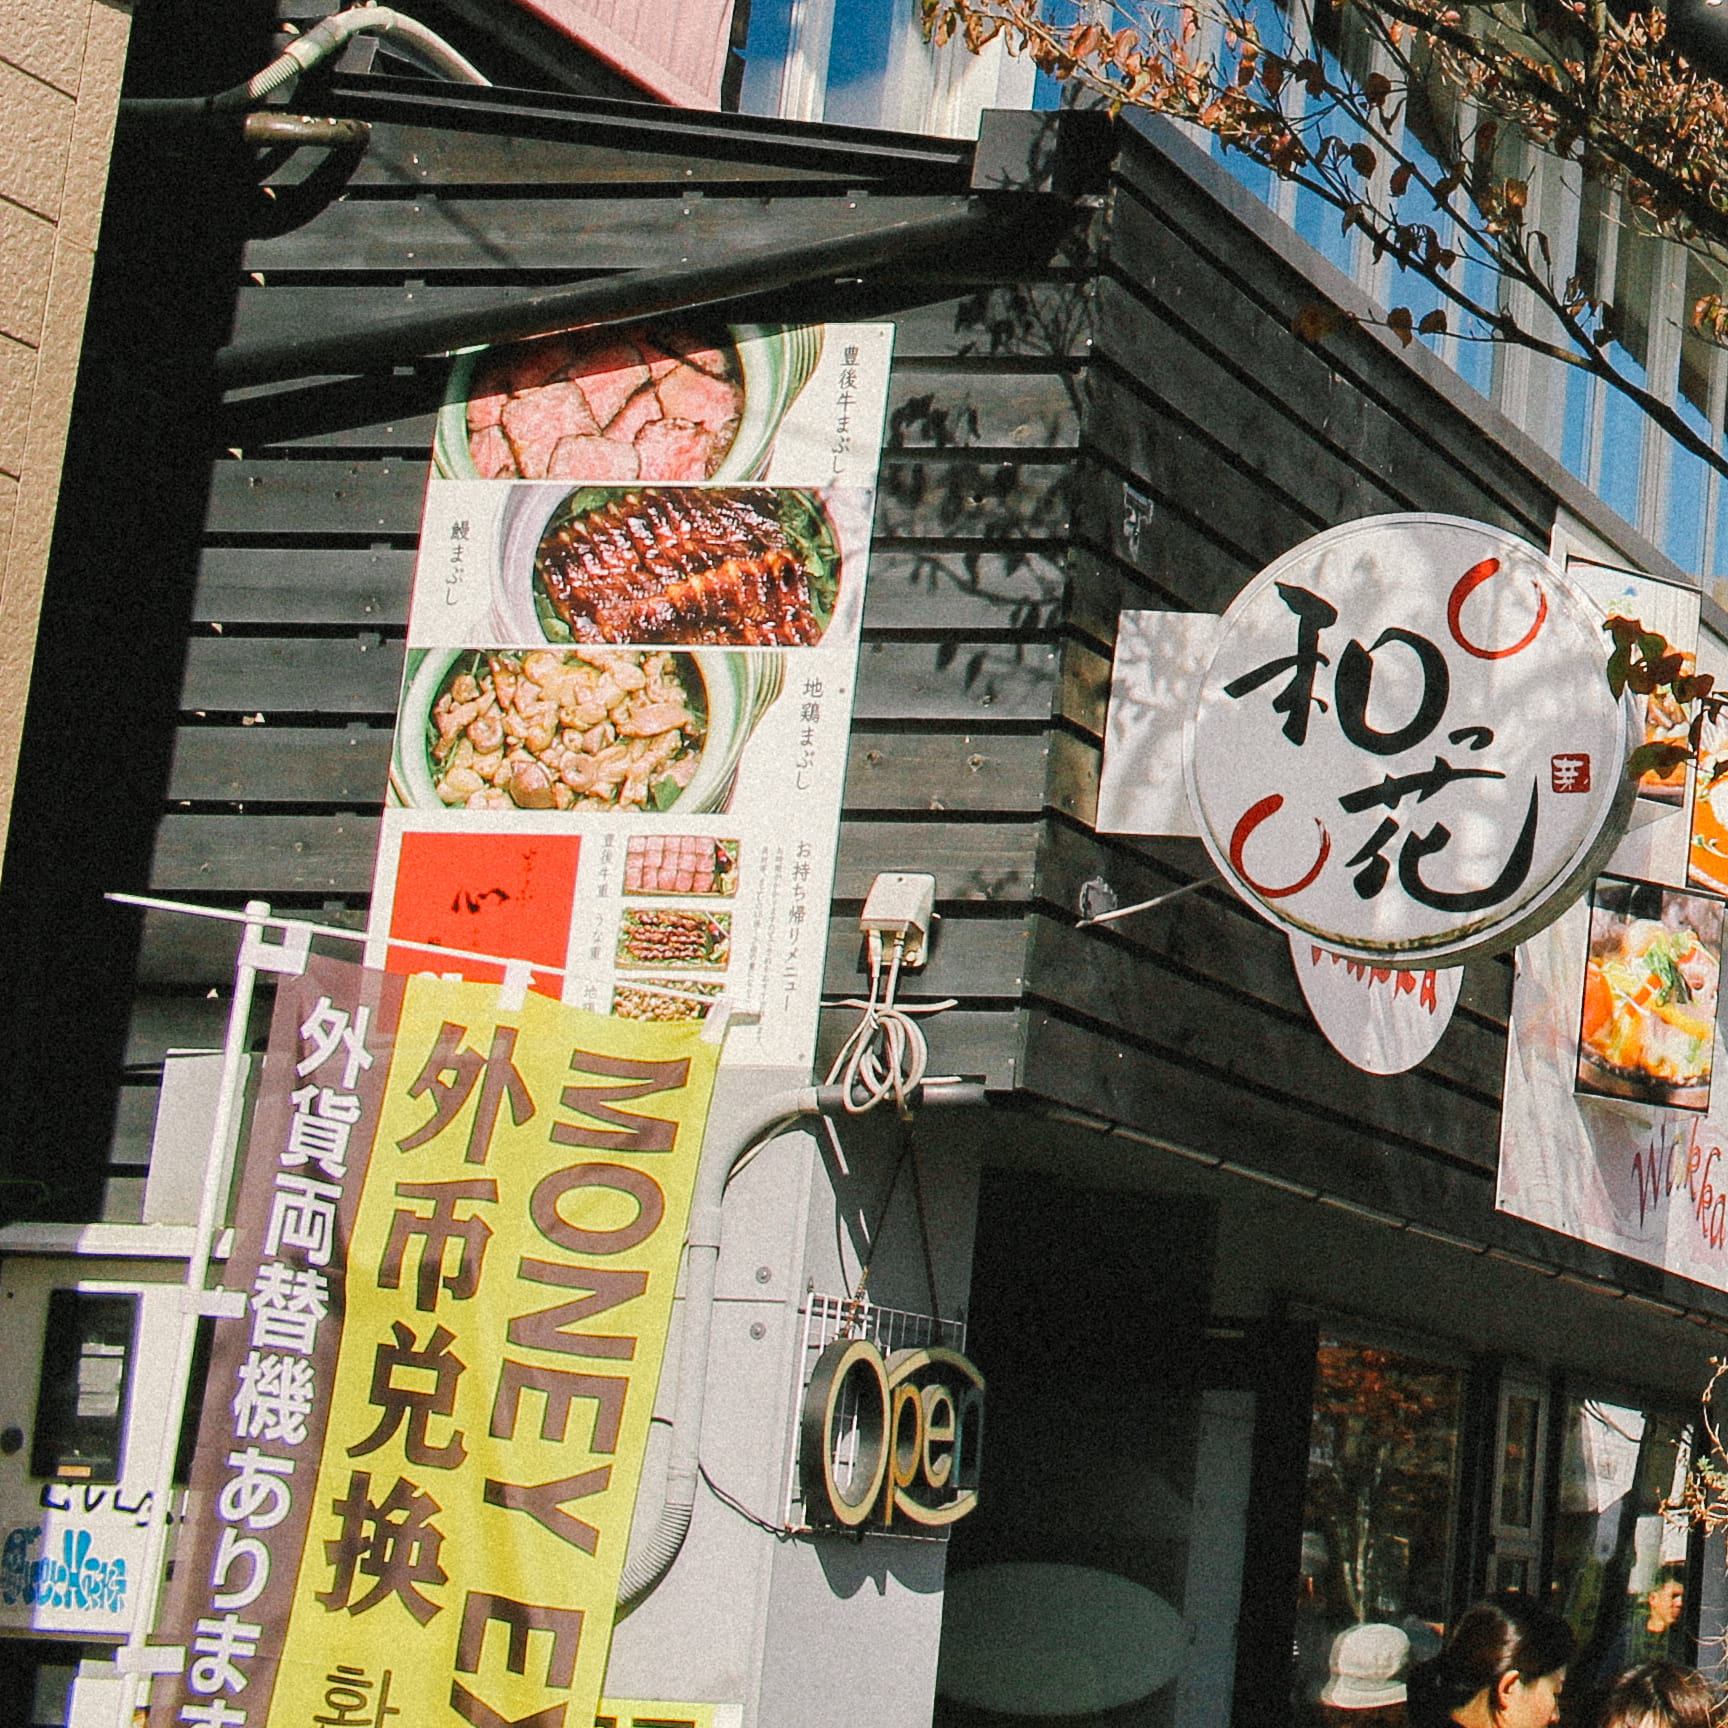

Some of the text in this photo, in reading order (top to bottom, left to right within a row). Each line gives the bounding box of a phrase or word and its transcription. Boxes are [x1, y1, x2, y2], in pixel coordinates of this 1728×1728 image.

[832, 345, 860, 474] 豊後牛まぶし
[796, 676, 824, 790] 地鶏まぶし
[783, 841, 811, 1011] お持ち帰りメニュー
[485, 1049, 690, 1561] MONEY
